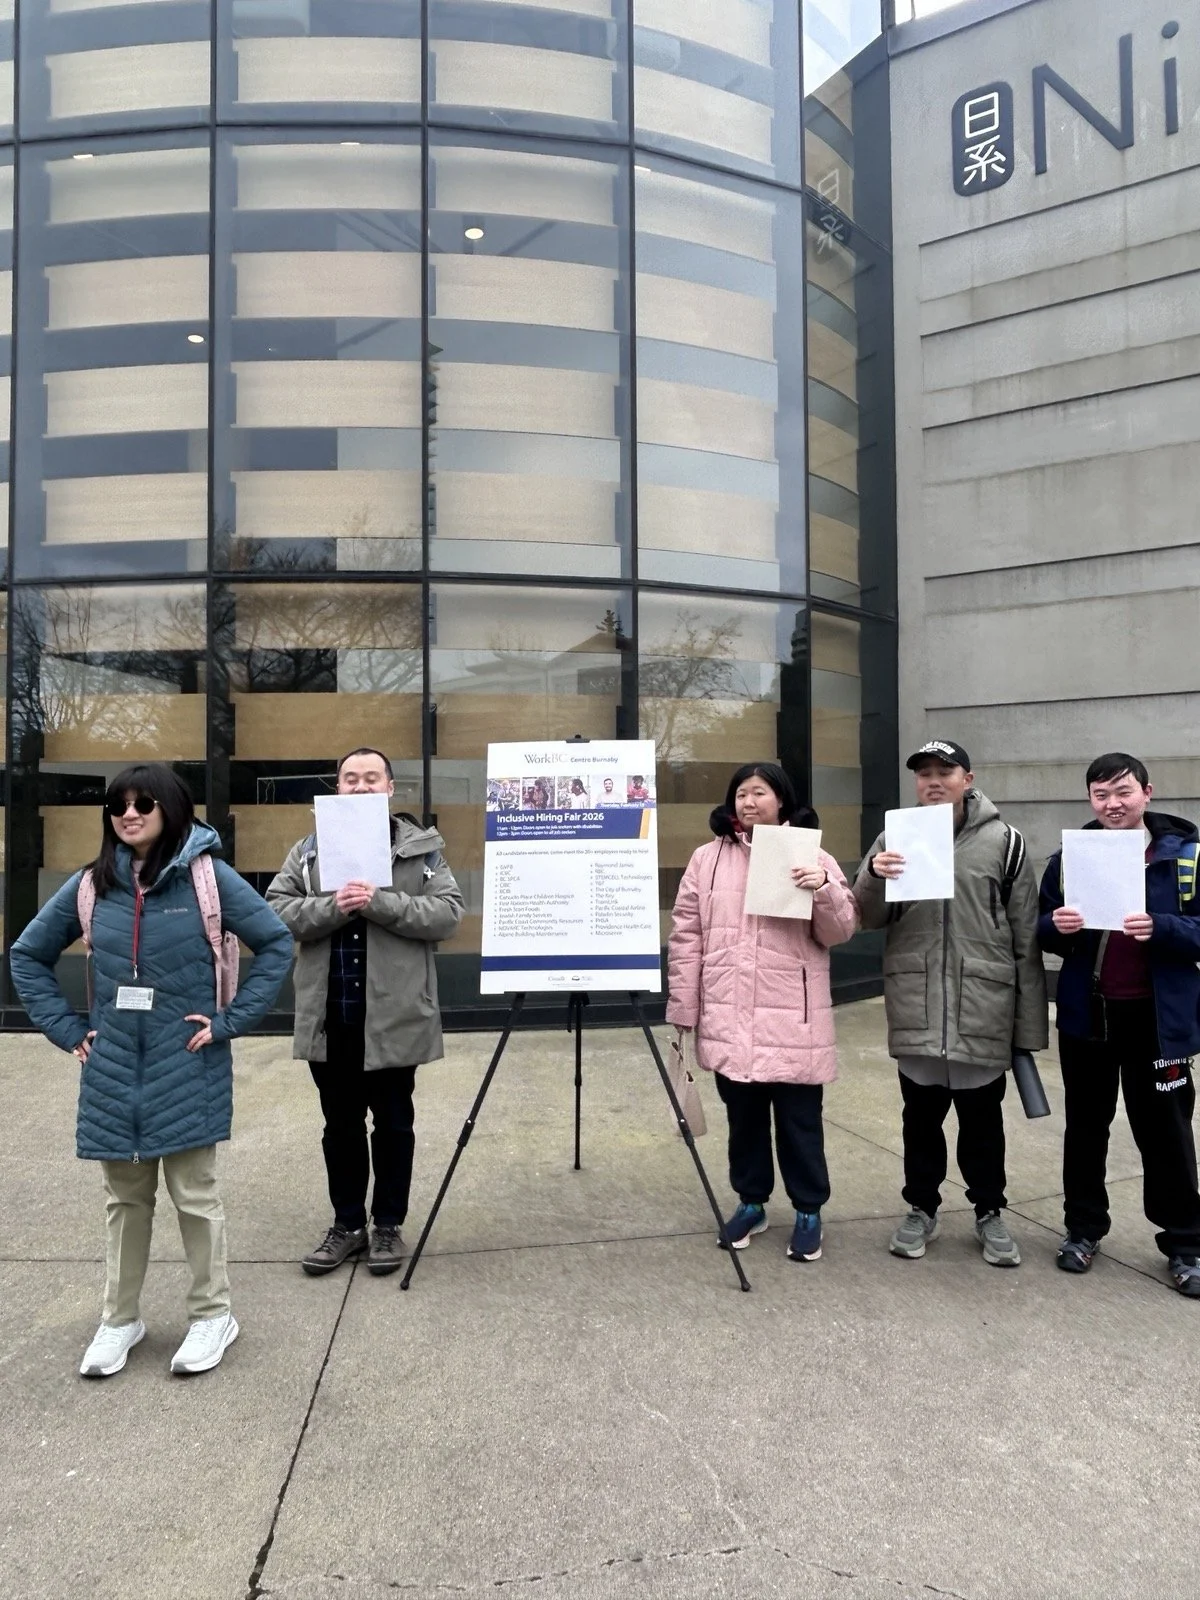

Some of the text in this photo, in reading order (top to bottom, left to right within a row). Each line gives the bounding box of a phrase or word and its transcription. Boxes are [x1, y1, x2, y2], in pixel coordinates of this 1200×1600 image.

[1032, 21, 1179, 175] Ni
[964, 92, 1006, 185] 日系
[524, 753, 568, 764] WorkBC
[592, 756, 618, 764] Burnaby
[497, 812, 605, 823] Inclusive Hiring Fair 2026
